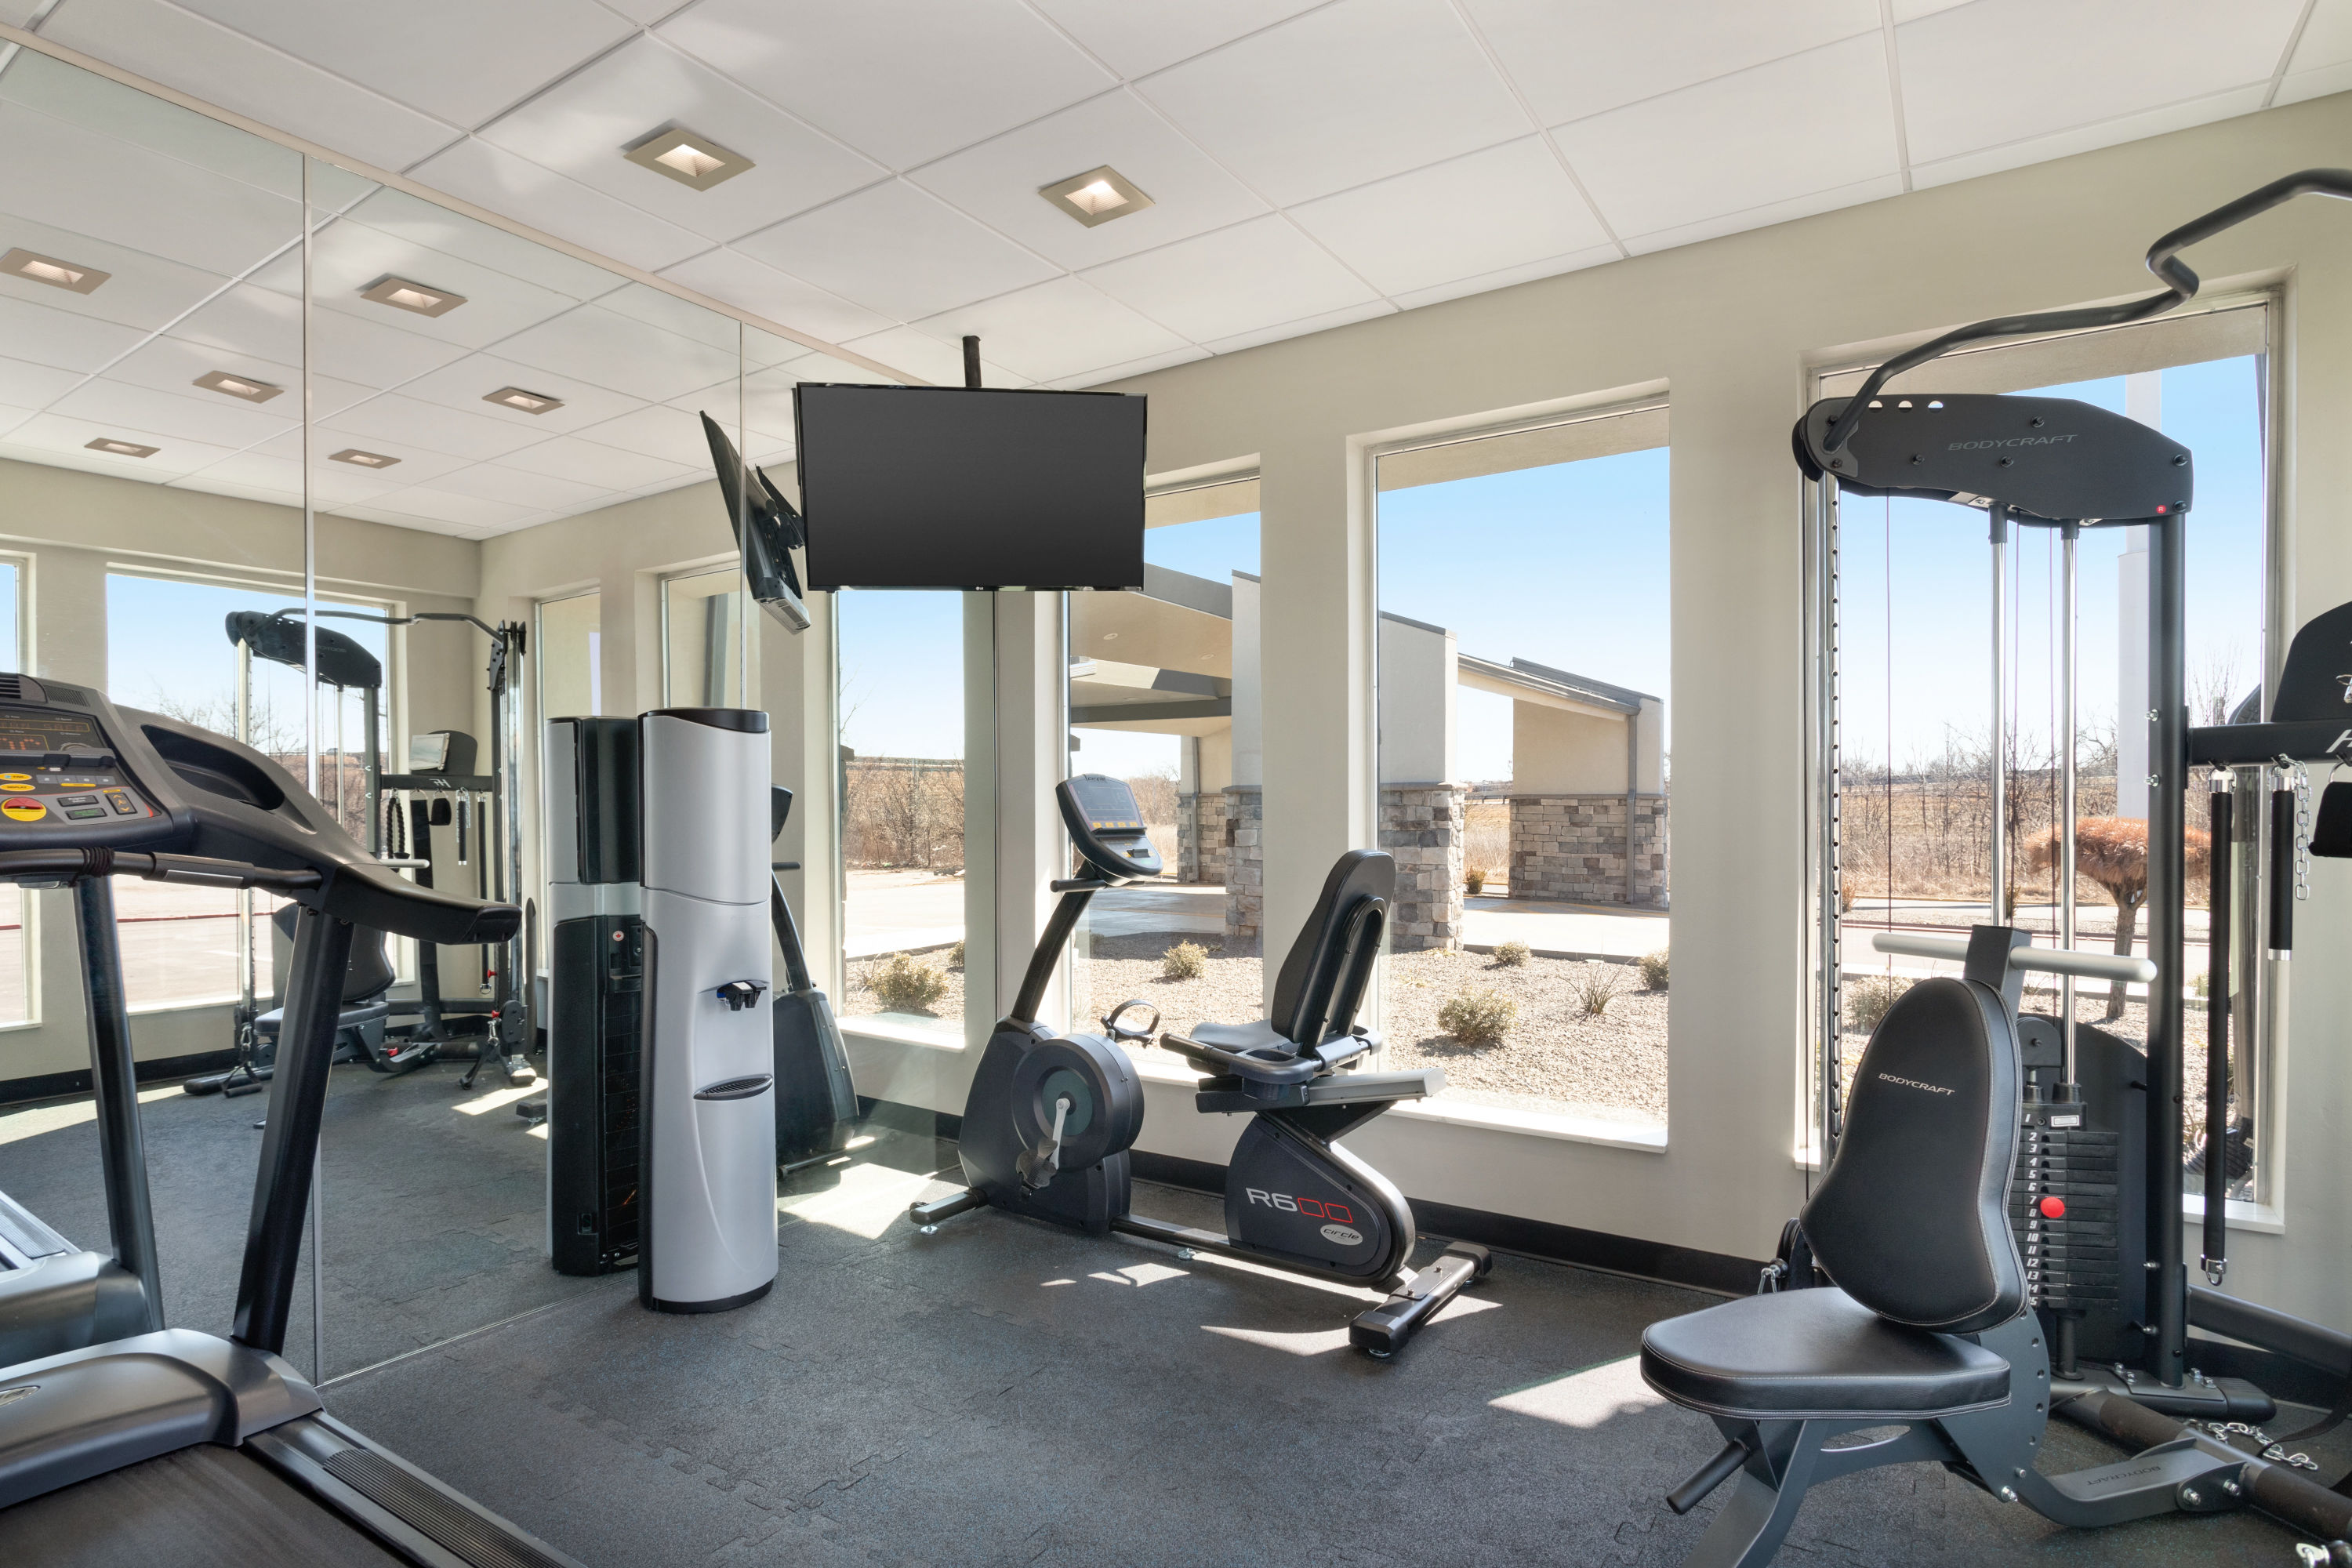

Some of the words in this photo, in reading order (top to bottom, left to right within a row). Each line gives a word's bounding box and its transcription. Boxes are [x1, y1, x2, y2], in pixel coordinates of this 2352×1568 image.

[1947, 434, 2078, 451] BODYCRAFT
[1878, 1073, 1955, 1096] BODYCRAFT
[2025, 1114, 2031, 1123] 1
[2029, 1132, 2037, 1141] 2
[2029, 1144, 2038, 1152] 3
[2030, 1157, 2038, 1167] 4
[2029, 1170, 2038, 1178] 5
[2028, 1182, 2037, 1191] 6
[2029, 1196, 2037, 1204] 7
[1246, 1188, 1353, 1223] R600
[2029, 1208, 2037, 1217] 8
[2029, 1220, 2038, 1229] 9
[1323, 1228, 1359, 1240] circle
[2027, 1233, 2039, 1242] 10
[2027, 1246, 2037, 1254] 11
[2027, 1258, 2038, 1267] 12
[2027, 1271, 2039, 1279] 13
[2087, 1465, 2161, 1485] BODYCRAFT
